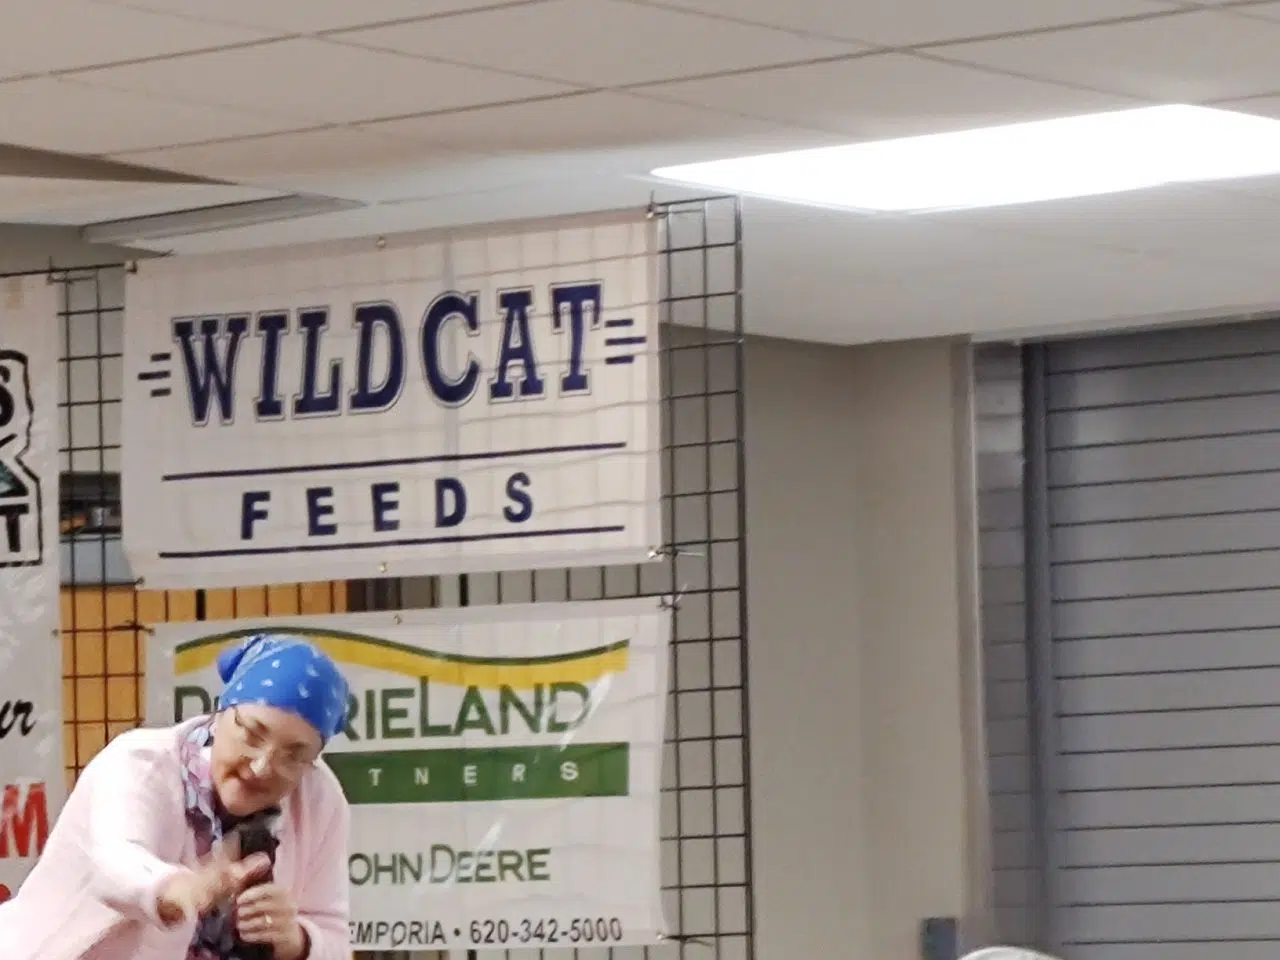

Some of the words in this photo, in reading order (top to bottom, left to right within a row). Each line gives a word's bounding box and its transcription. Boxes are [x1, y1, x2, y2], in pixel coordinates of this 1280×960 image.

[171, 280, 604, 427] WILDCAT
[240, 472, 534, 540] FEEDS
[369, 760, 579, 787] TNERS
[348, 851, 423, 885] OHN
[430, 844, 551, 884] DEERE
[470, 917, 623, 944] 620-342-5000
